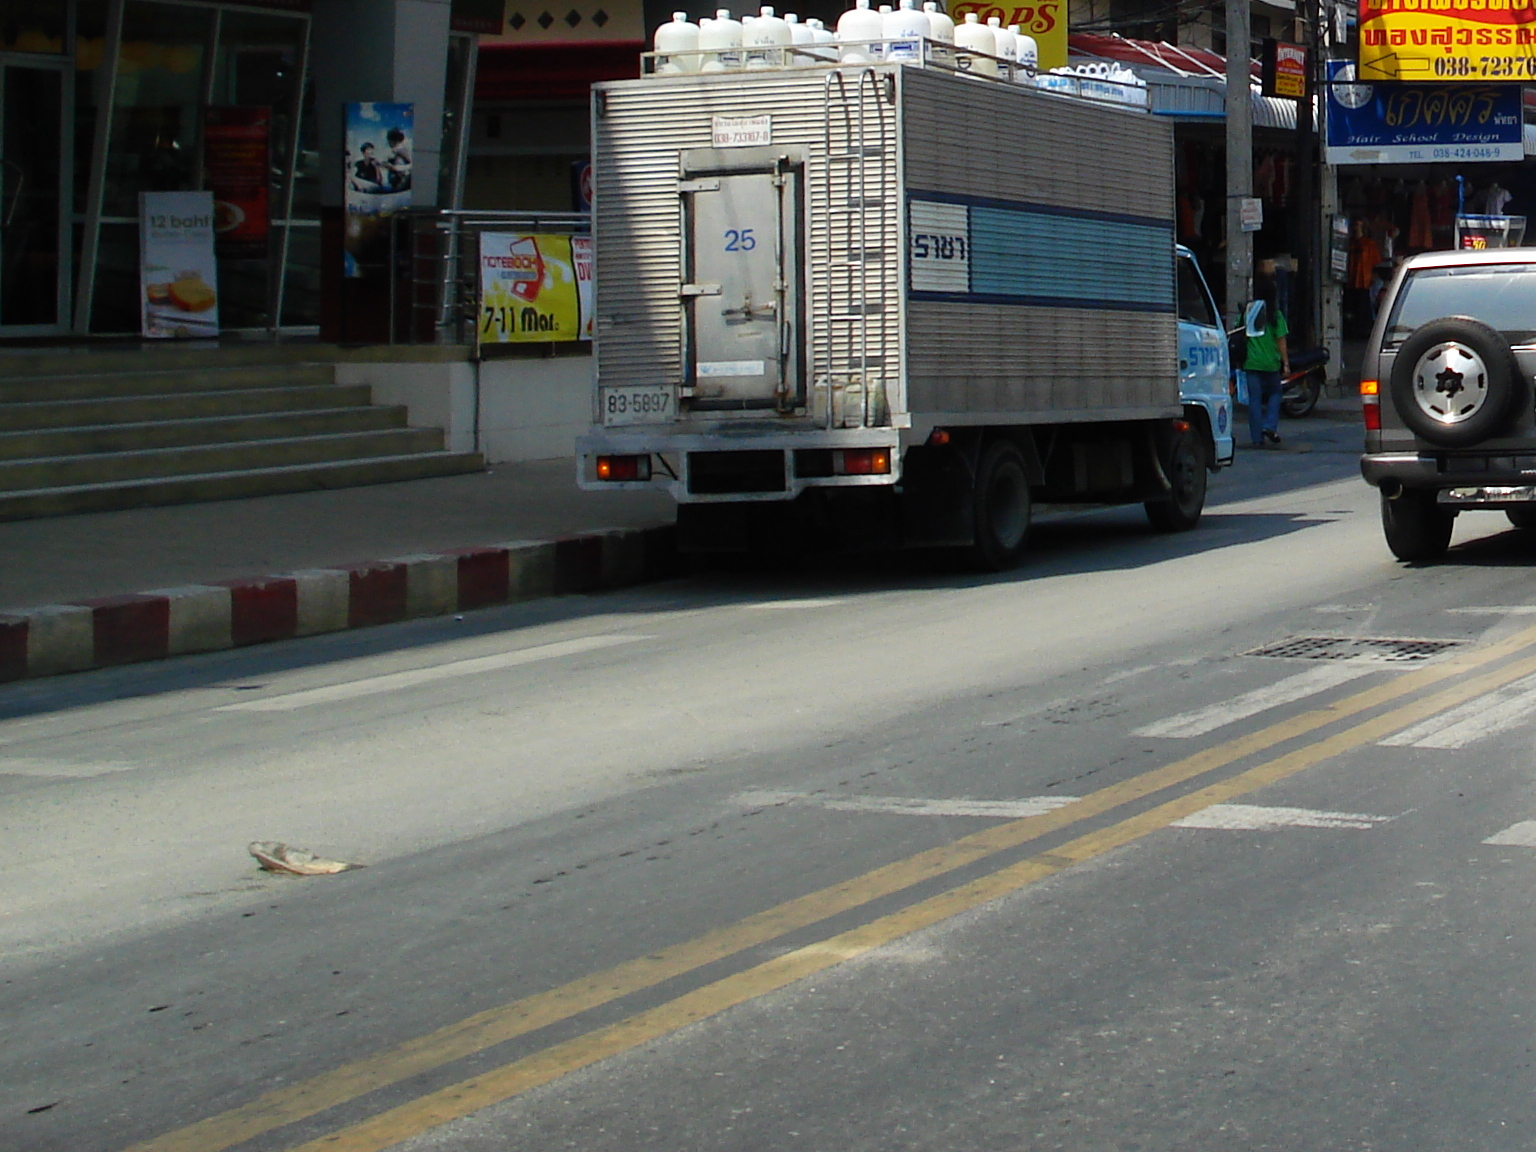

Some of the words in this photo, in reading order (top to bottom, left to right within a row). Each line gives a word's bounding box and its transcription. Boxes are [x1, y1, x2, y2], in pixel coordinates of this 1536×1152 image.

[1347, 134, 1382, 144] Hair
[1392, 133, 1438, 144] School
[1452, 133, 1500, 144] Design
[723, 228, 757, 252] 25
[484, 307, 516, 334] 7-11
[607, 393, 670, 413] 83-5897
